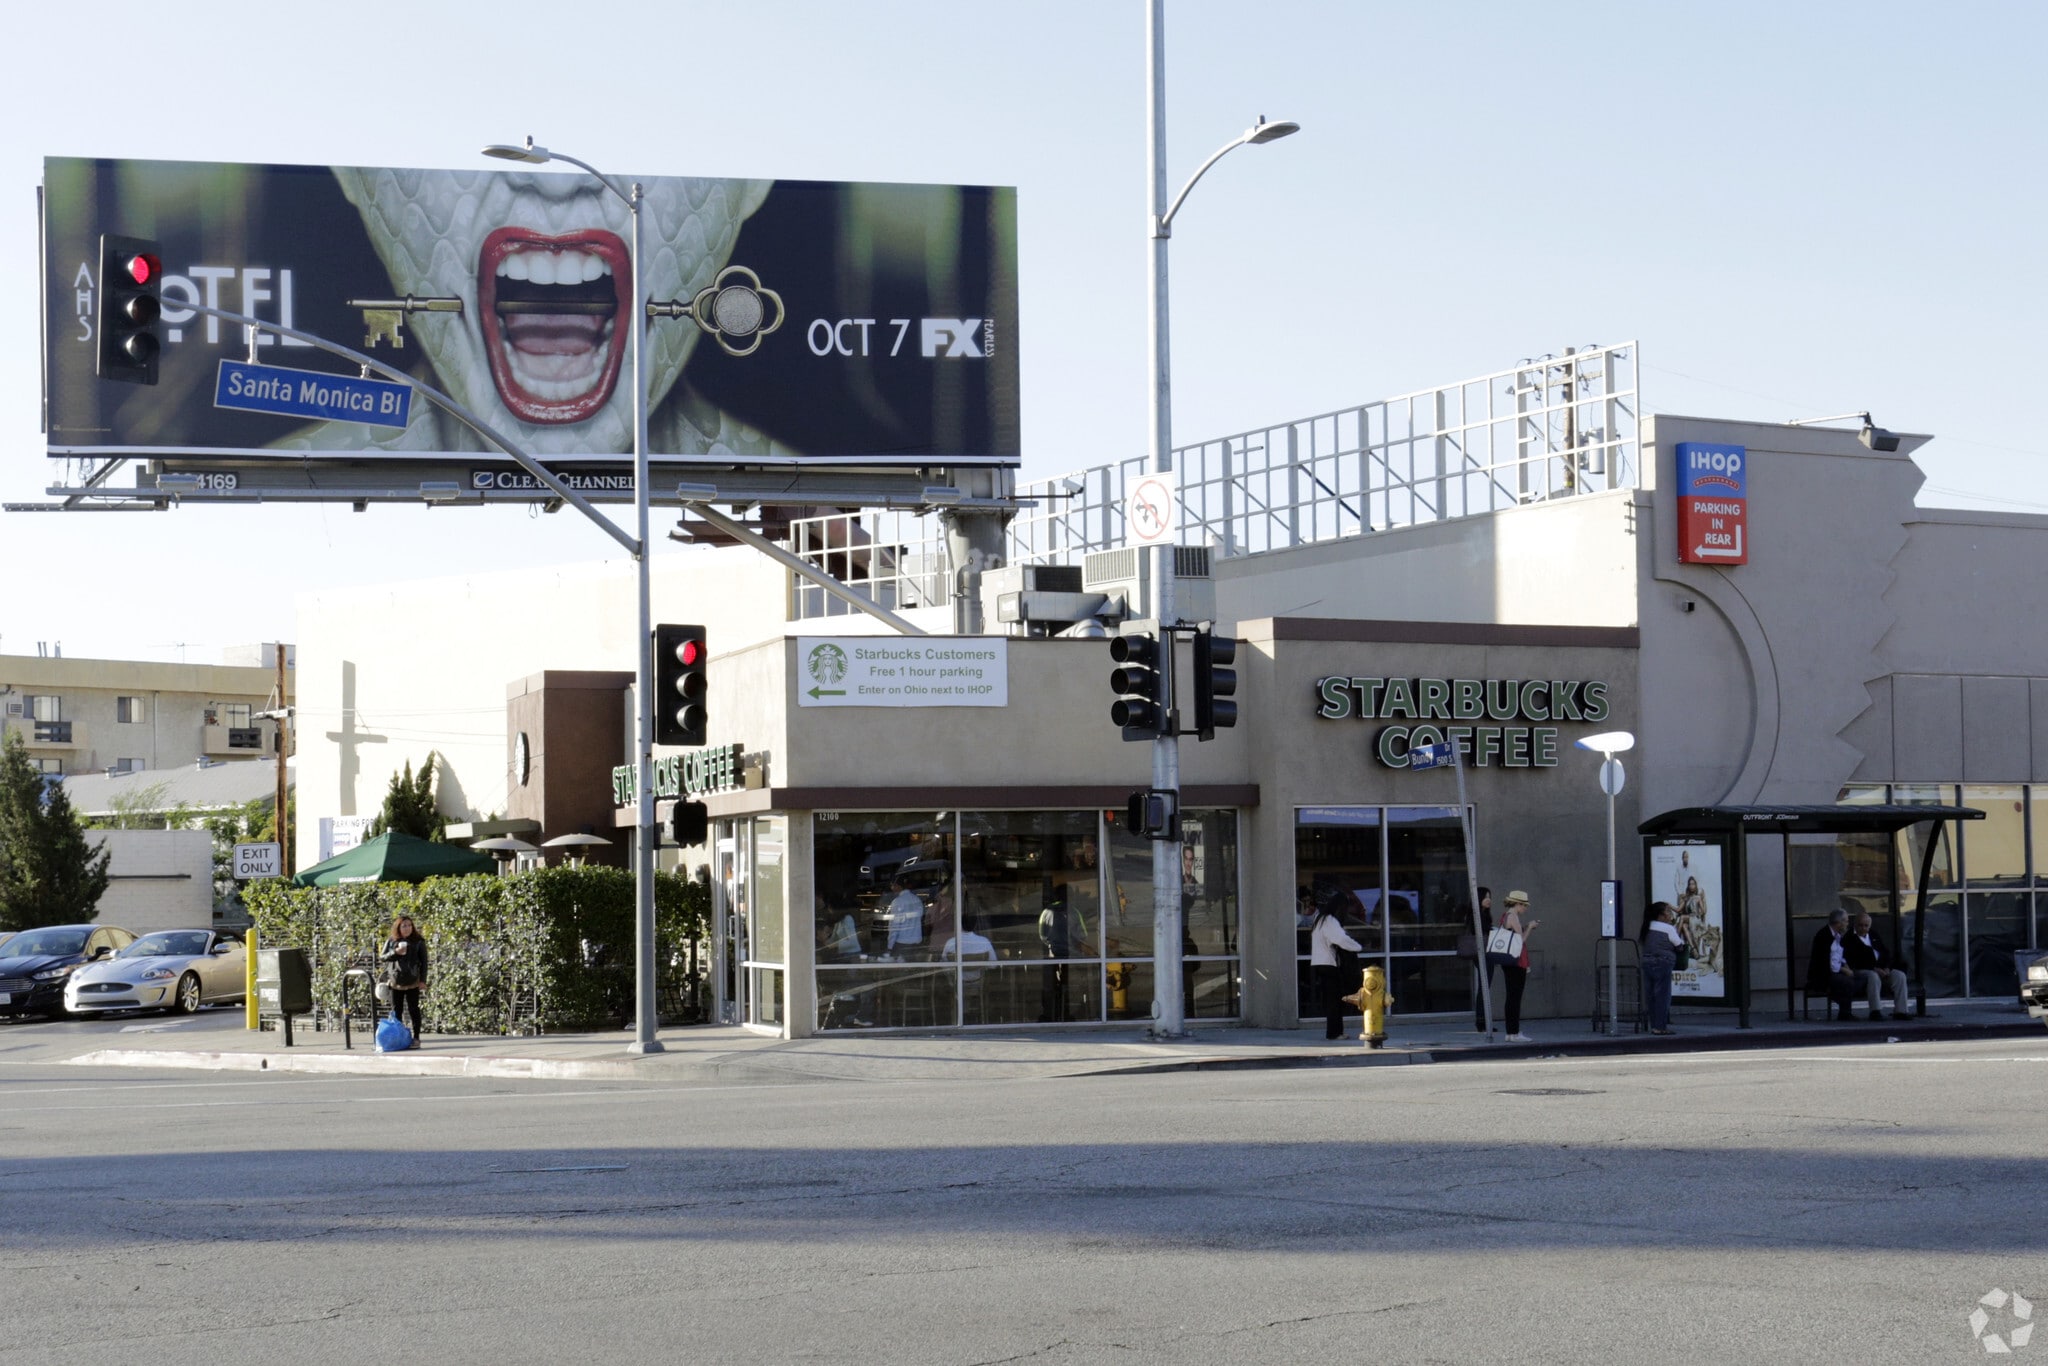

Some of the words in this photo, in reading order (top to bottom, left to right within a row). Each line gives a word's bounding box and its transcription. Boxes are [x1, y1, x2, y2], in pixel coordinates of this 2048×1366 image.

[74, 262, 94, 341] AHS
[160, 266, 316, 347] OTEL
[807, 318, 876, 357] OCT
[889, 319, 911, 357] 7
[921, 318, 983, 357] FX
[984, 319, 995, 357] FEARLESS
[228, 372, 292, 402] Santa
[299, 381, 374, 412] Monica
[1690, 451, 1742, 477] IHOP
[497, 472, 551, 489] CLEA
[1694, 502, 1741, 515] PARKING
[1712, 518, 1723, 529] IN
[1705, 533, 1731, 545] REAR
[855, 649, 921, 660] Starbucks
[925, 649, 996, 660] Customers
[870, 666, 895, 677] Free
[899, 666, 905, 677] 1
[909, 666, 936, 677] hour
[940, 666, 983, 679] parking
[858, 685, 887, 695] Enter
[904, 685, 928, 695] Ohio
[931, 686, 953, 695] next
[954, 686, 965, 695] to
[968, 685, 993, 694] IHOP
[1319, 676, 1610, 722] STARBUCKS
[683, 744, 735, 793] COFFEE
[819, 812, 840, 821] 12100
[242, 848, 271, 859] EXIT
[240, 862, 273, 874] ONLY
[1671, 972, 1697, 986] pire
